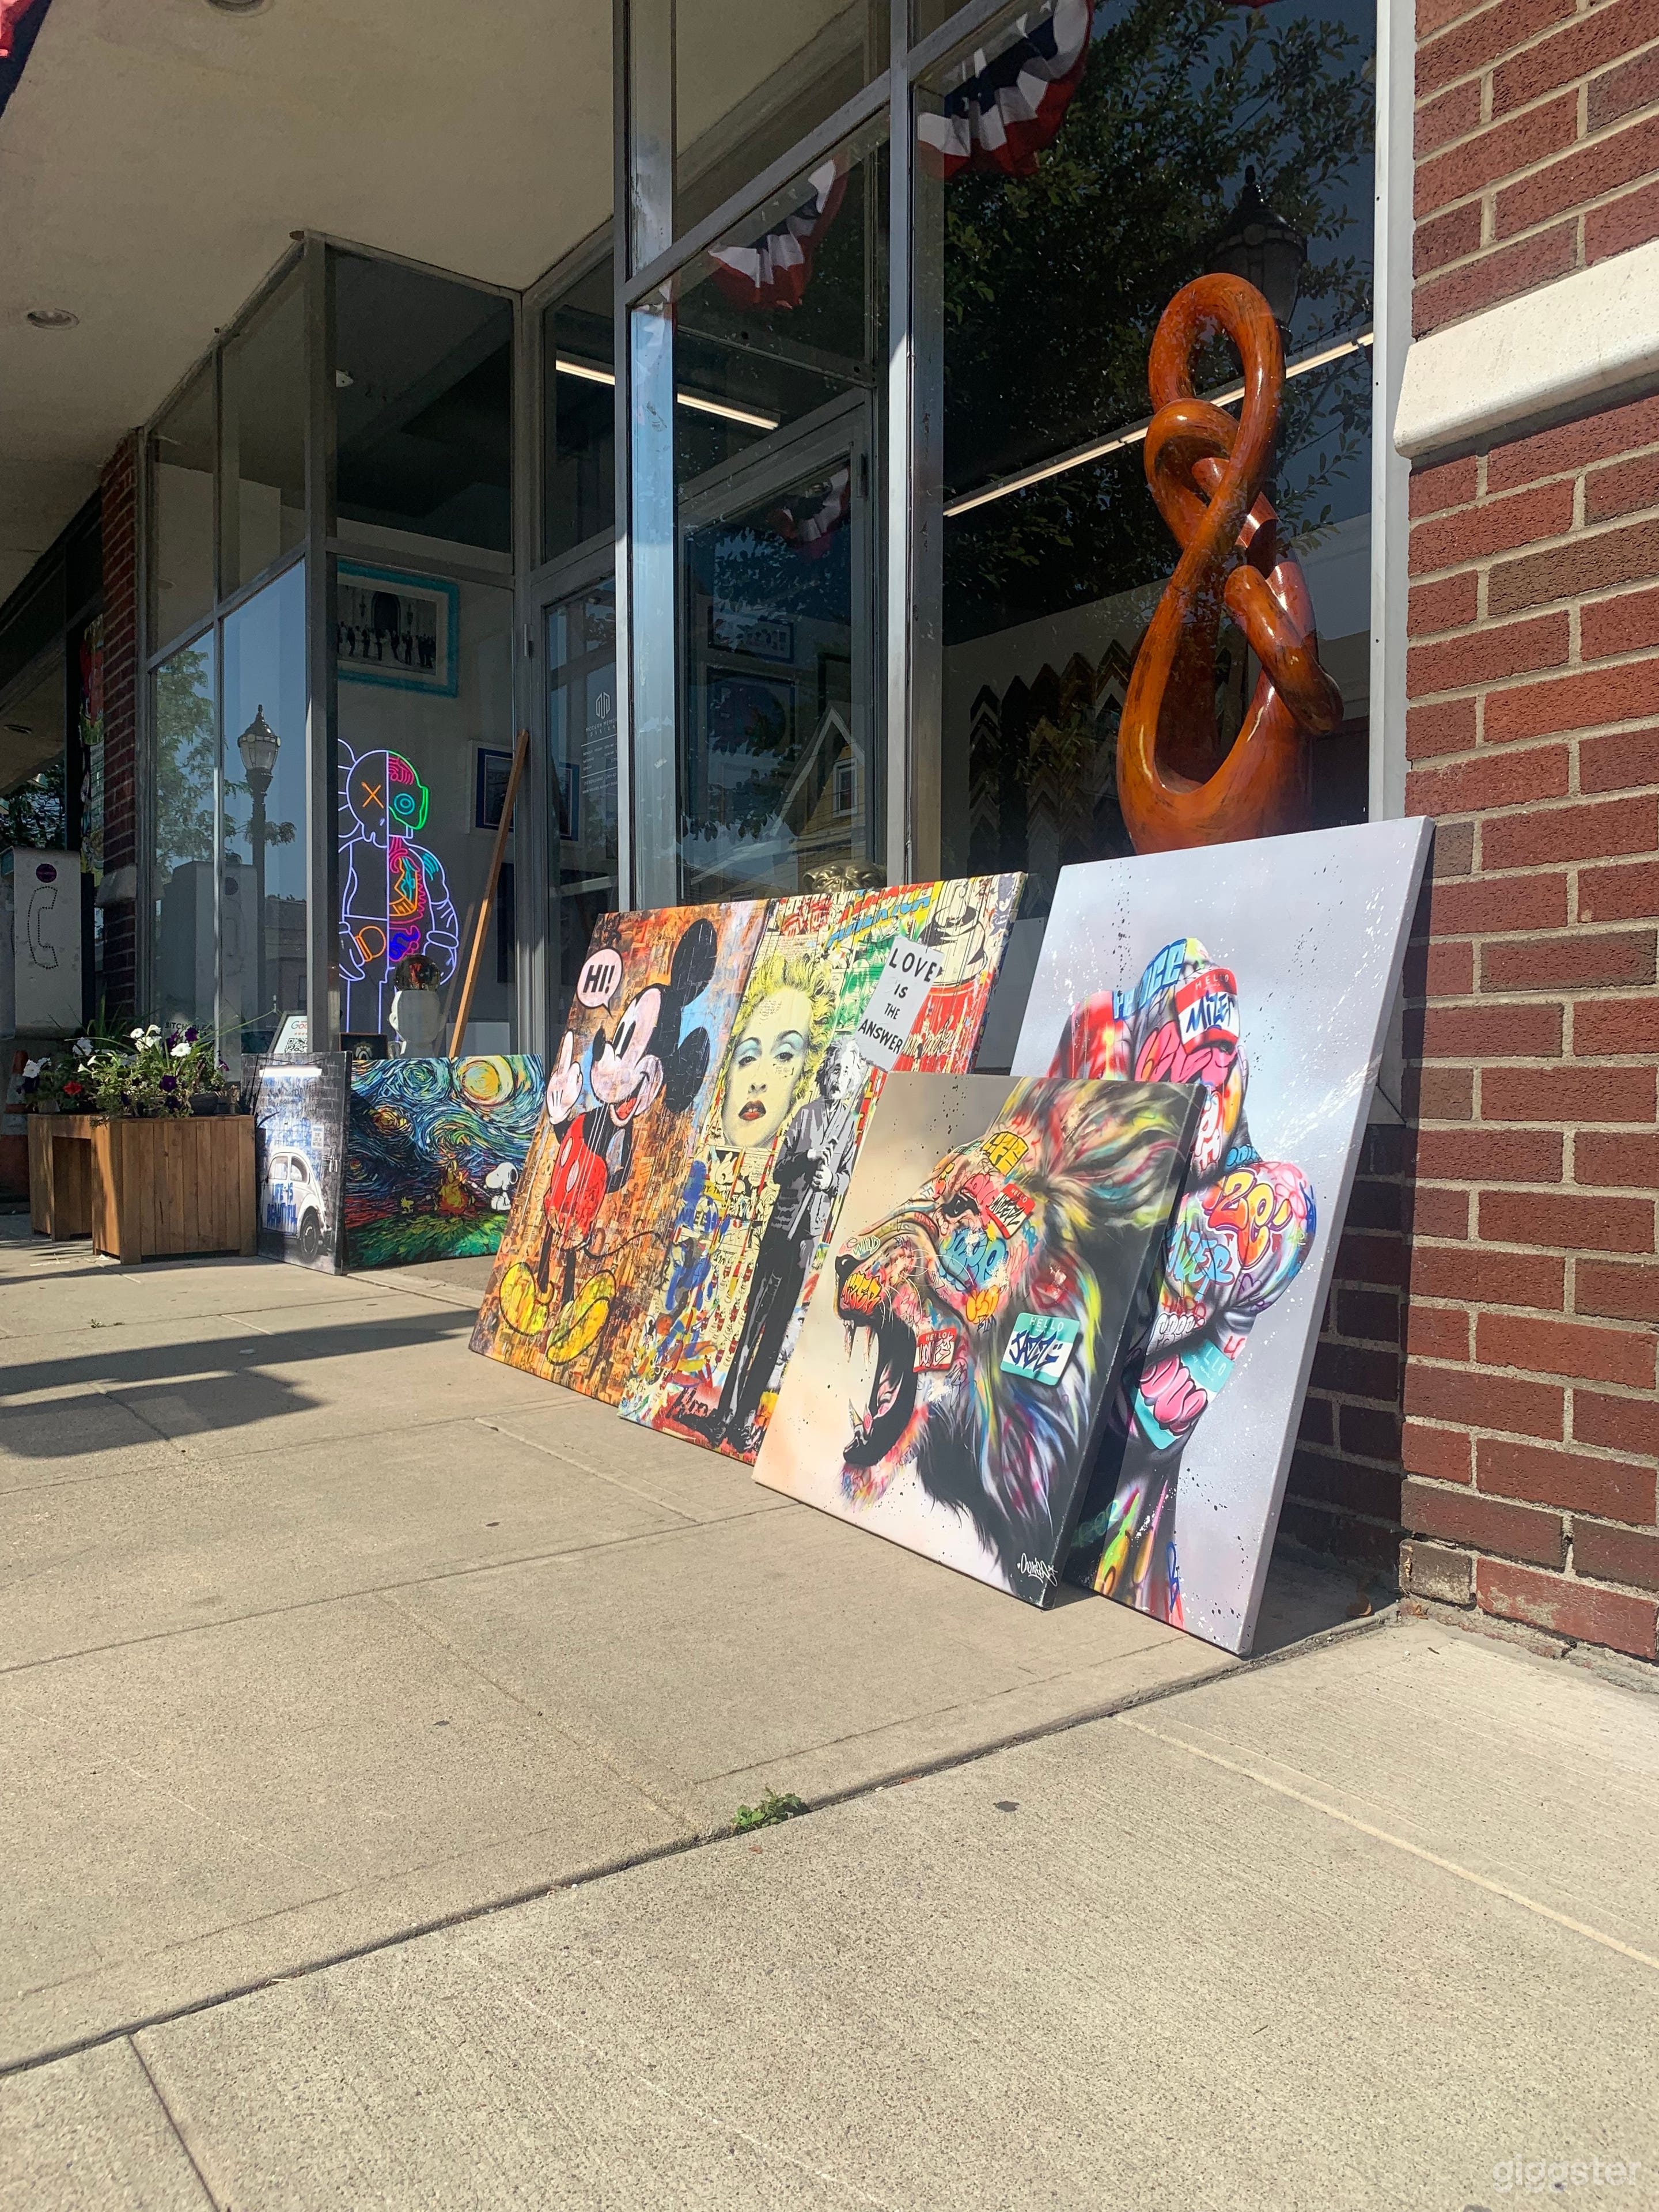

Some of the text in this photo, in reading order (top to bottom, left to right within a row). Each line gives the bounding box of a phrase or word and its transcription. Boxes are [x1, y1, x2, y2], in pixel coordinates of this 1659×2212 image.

[889, 948, 938, 983] LOVE
[583, 965, 615, 993] HI!
[1195, 974, 1229, 991] HELO
[894, 983, 907, 998] IS
[884, 1002, 900, 1020] THE
[858, 1018, 903, 1055] ANSWER
[1011, 1188, 1028, 1203] HELLO
[1029, 1317, 1065, 1332] HELLO
